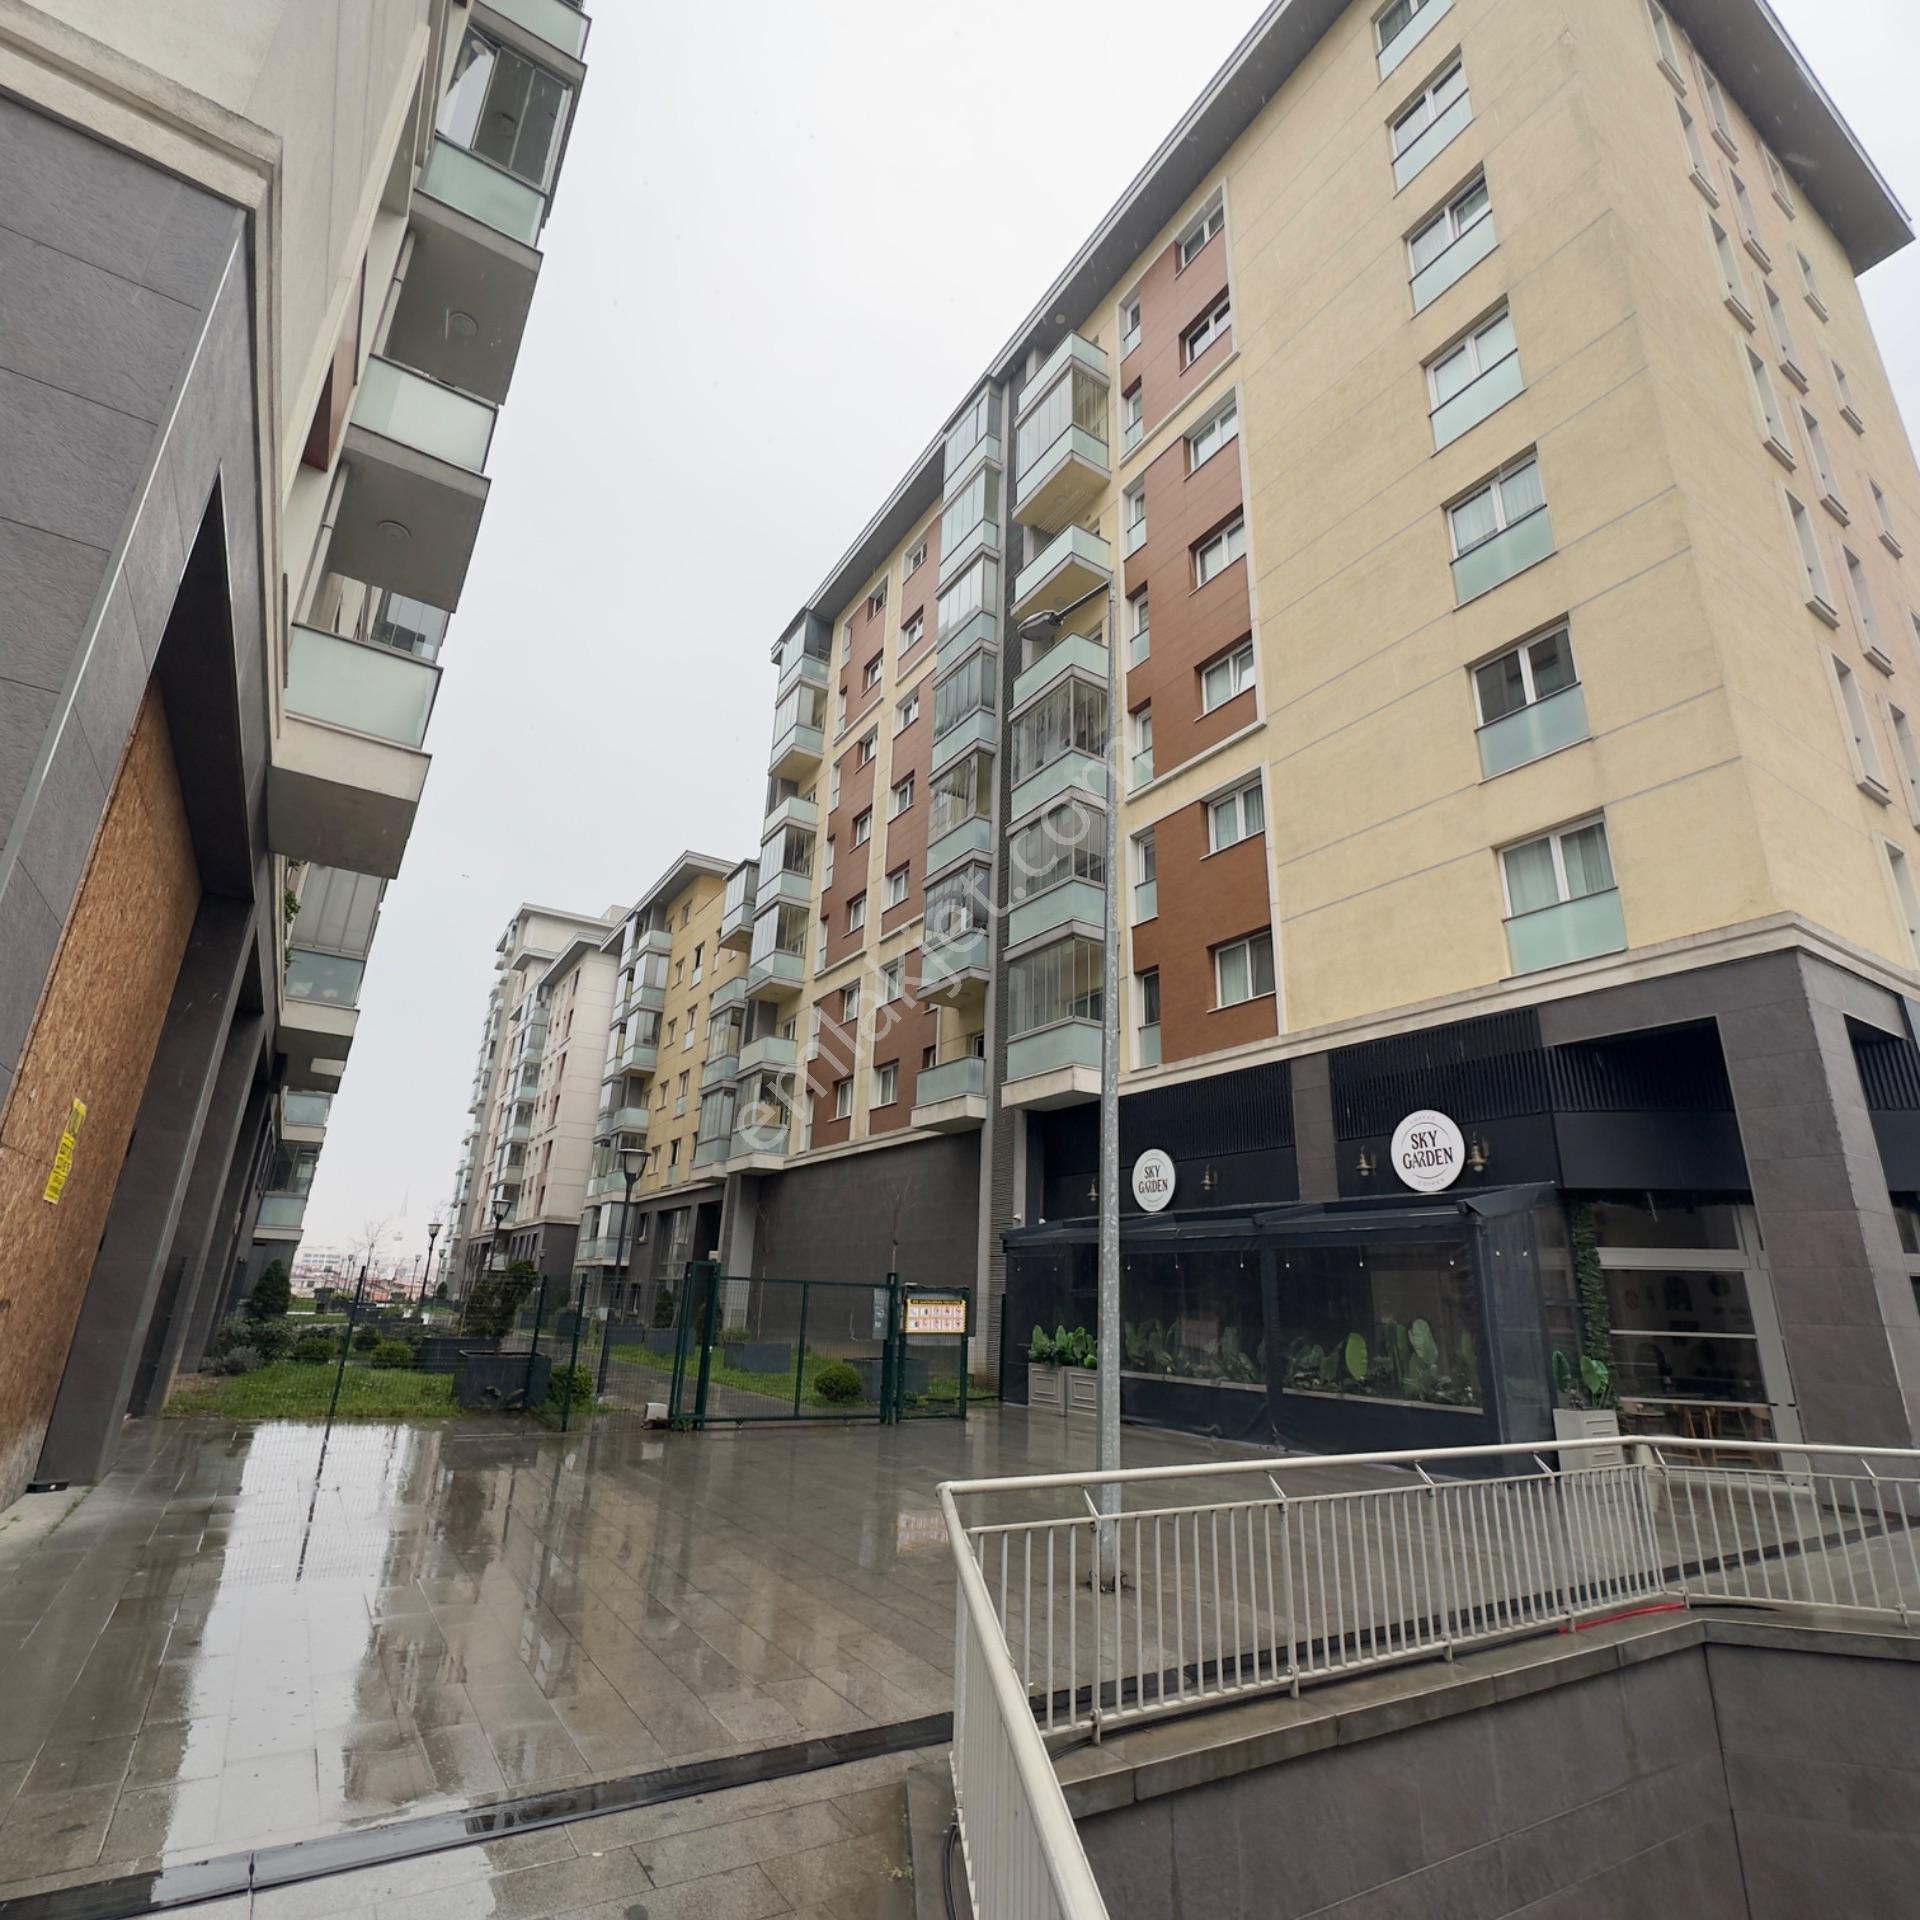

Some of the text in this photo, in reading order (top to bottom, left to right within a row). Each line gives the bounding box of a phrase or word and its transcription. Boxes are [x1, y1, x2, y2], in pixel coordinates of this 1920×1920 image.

[1410, 1130, 1437, 1150] SKY
[1402, 1147, 1454, 1170] GARDEN
[1144, 1165, 1160, 1179] SKY
[1138, 1178, 1168, 1194] GARDEN
